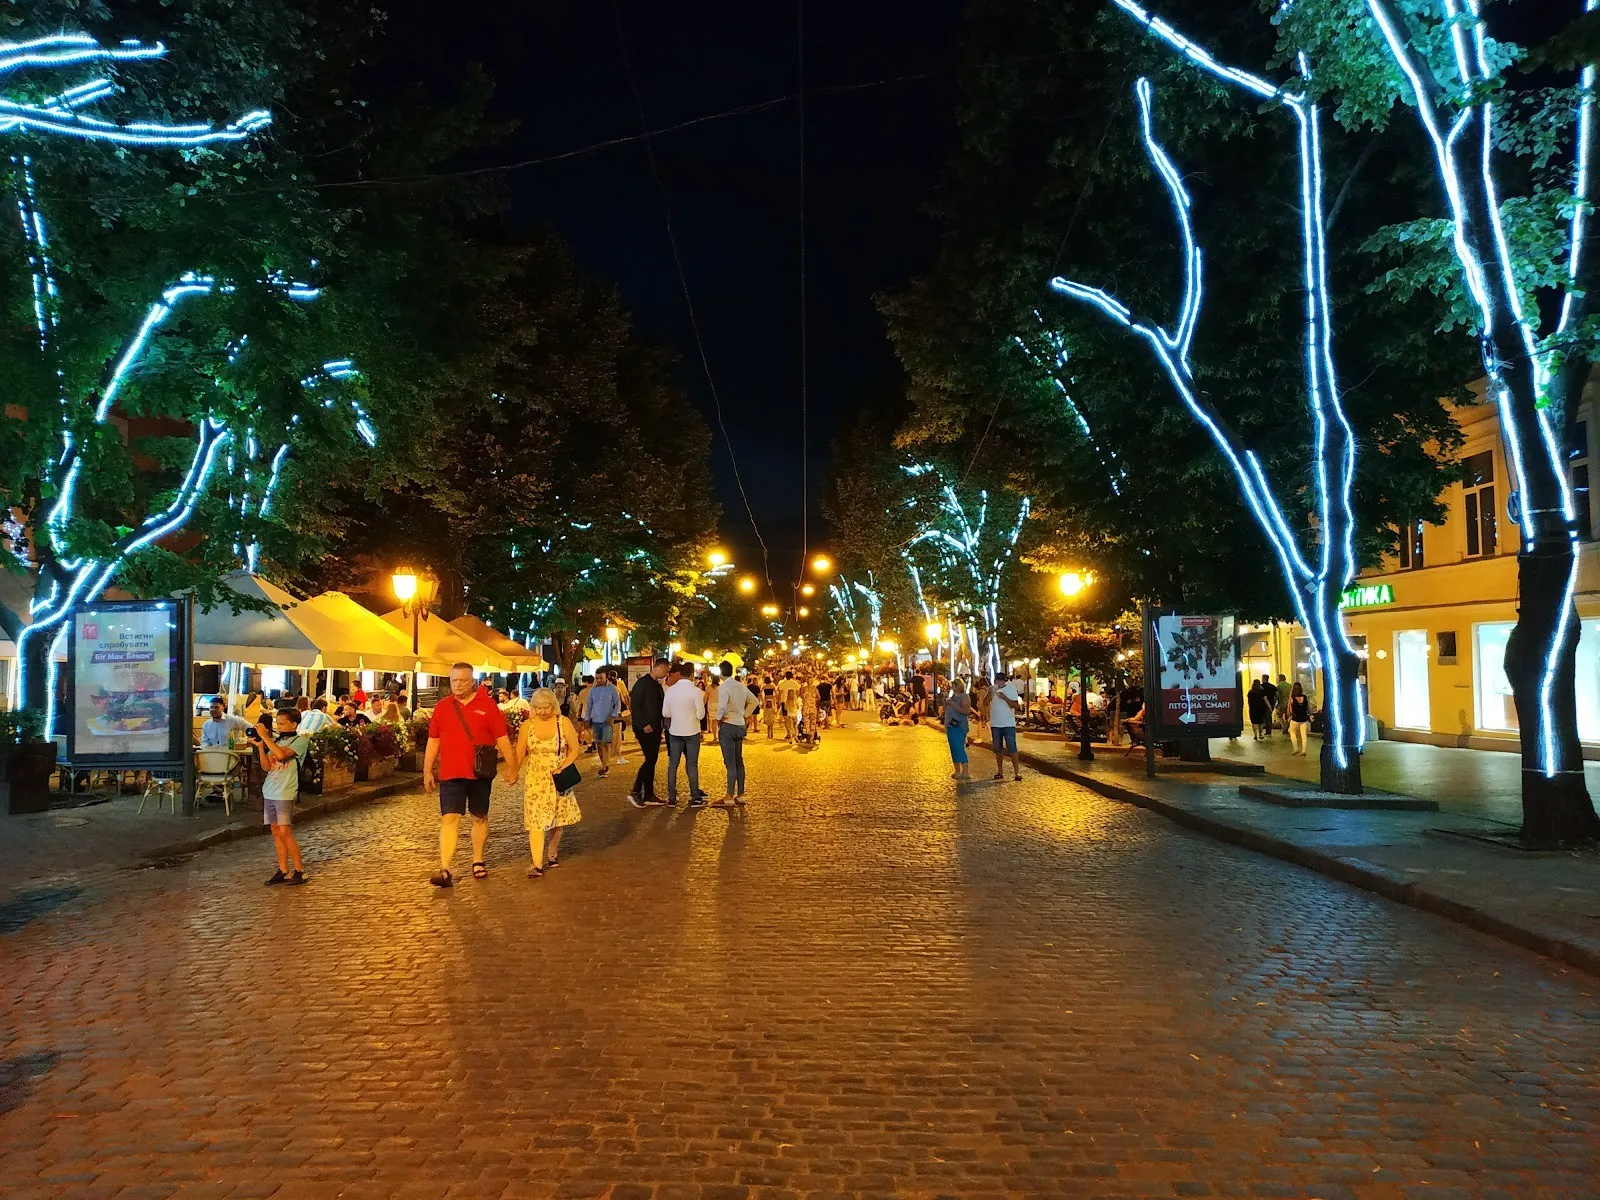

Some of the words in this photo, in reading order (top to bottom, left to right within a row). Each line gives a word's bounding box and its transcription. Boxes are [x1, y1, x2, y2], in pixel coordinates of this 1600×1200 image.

[99, 641, 149, 650] спробувати
[1180, 693, 1218, 701] СПРОБУЙ
[1168, 702, 1188, 710] ЛІТО
[1205, 701, 1230, 709] СМАК!
